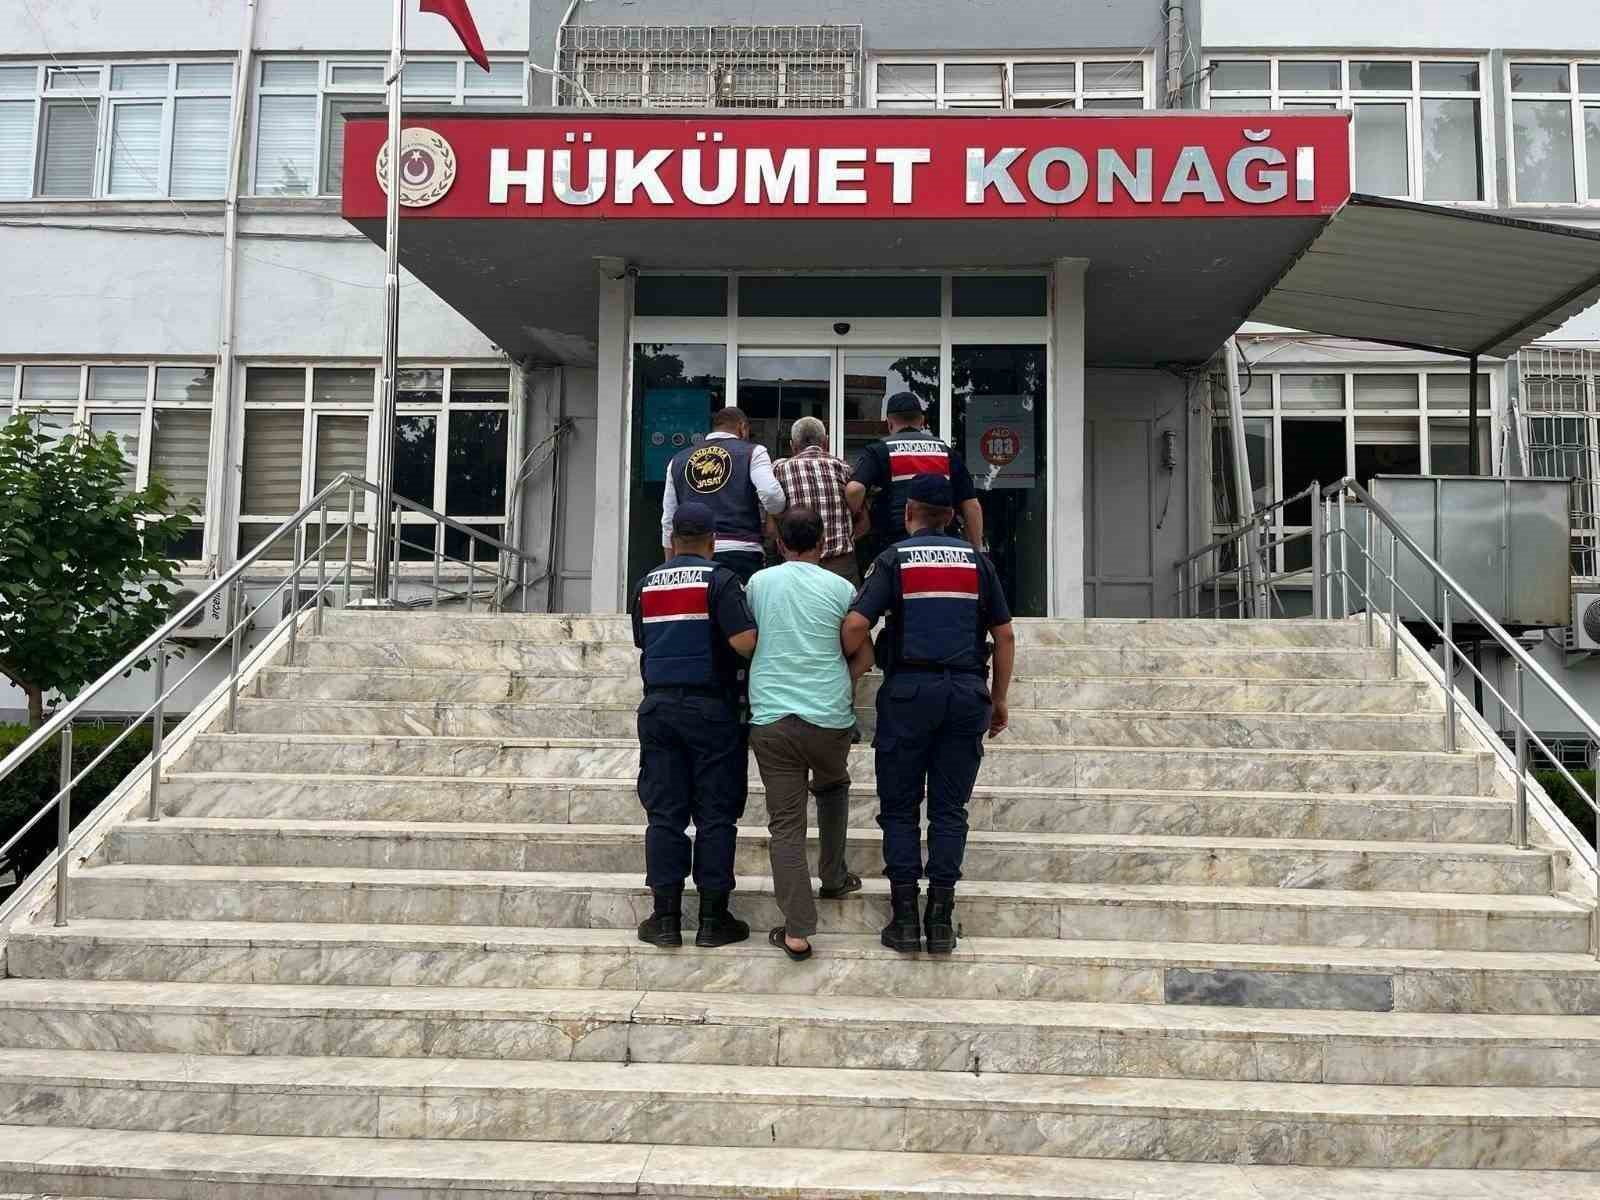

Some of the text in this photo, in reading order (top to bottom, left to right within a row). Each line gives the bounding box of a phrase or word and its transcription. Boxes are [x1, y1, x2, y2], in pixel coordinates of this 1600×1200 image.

[489, 129, 1315, 205] HÜKÜMET KONAĞI
[895, 442, 943, 453] JANDARMA
[696, 476, 722, 489] JASAT
[907, 550, 971, 564] JANDARMA
[647, 570, 704, 586] JANDARMA
